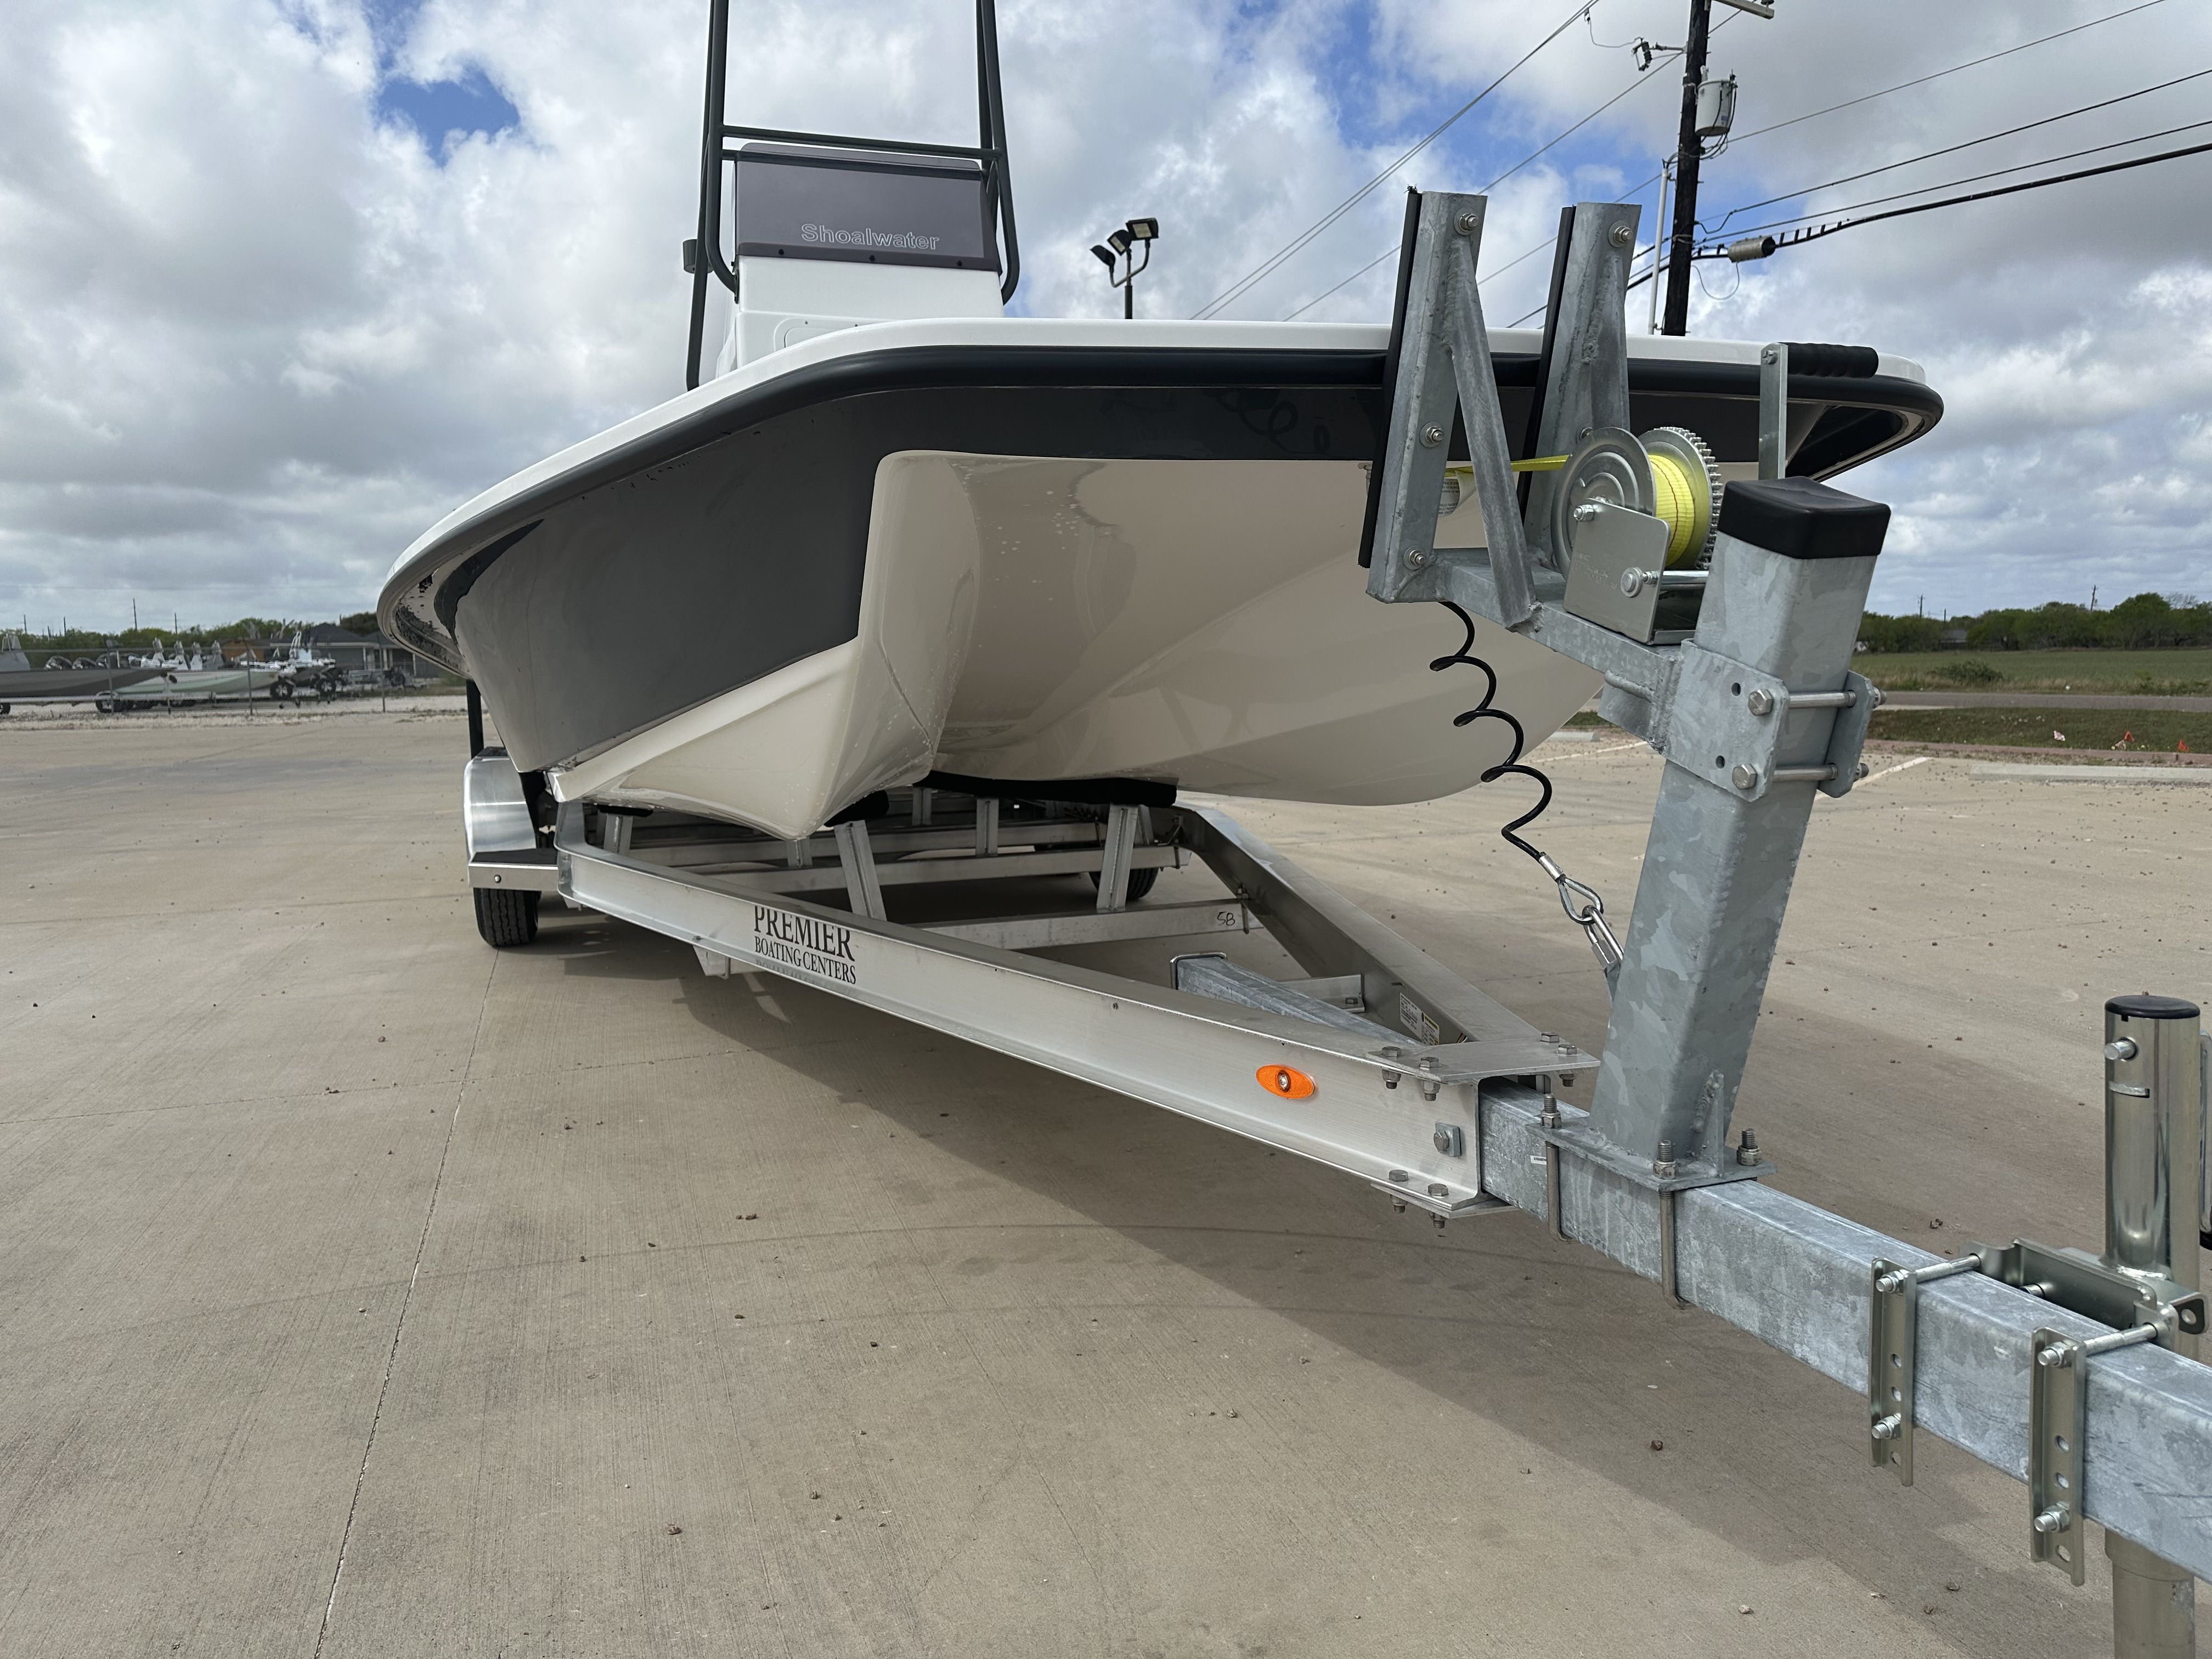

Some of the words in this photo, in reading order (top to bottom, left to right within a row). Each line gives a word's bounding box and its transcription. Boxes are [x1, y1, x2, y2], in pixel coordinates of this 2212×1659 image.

[801, 223, 940, 250] Shoalwater
[754, 905, 855, 961] PREMIER
[754, 936, 802, 967] BOATING
[803, 951, 856, 984] CENTERS
